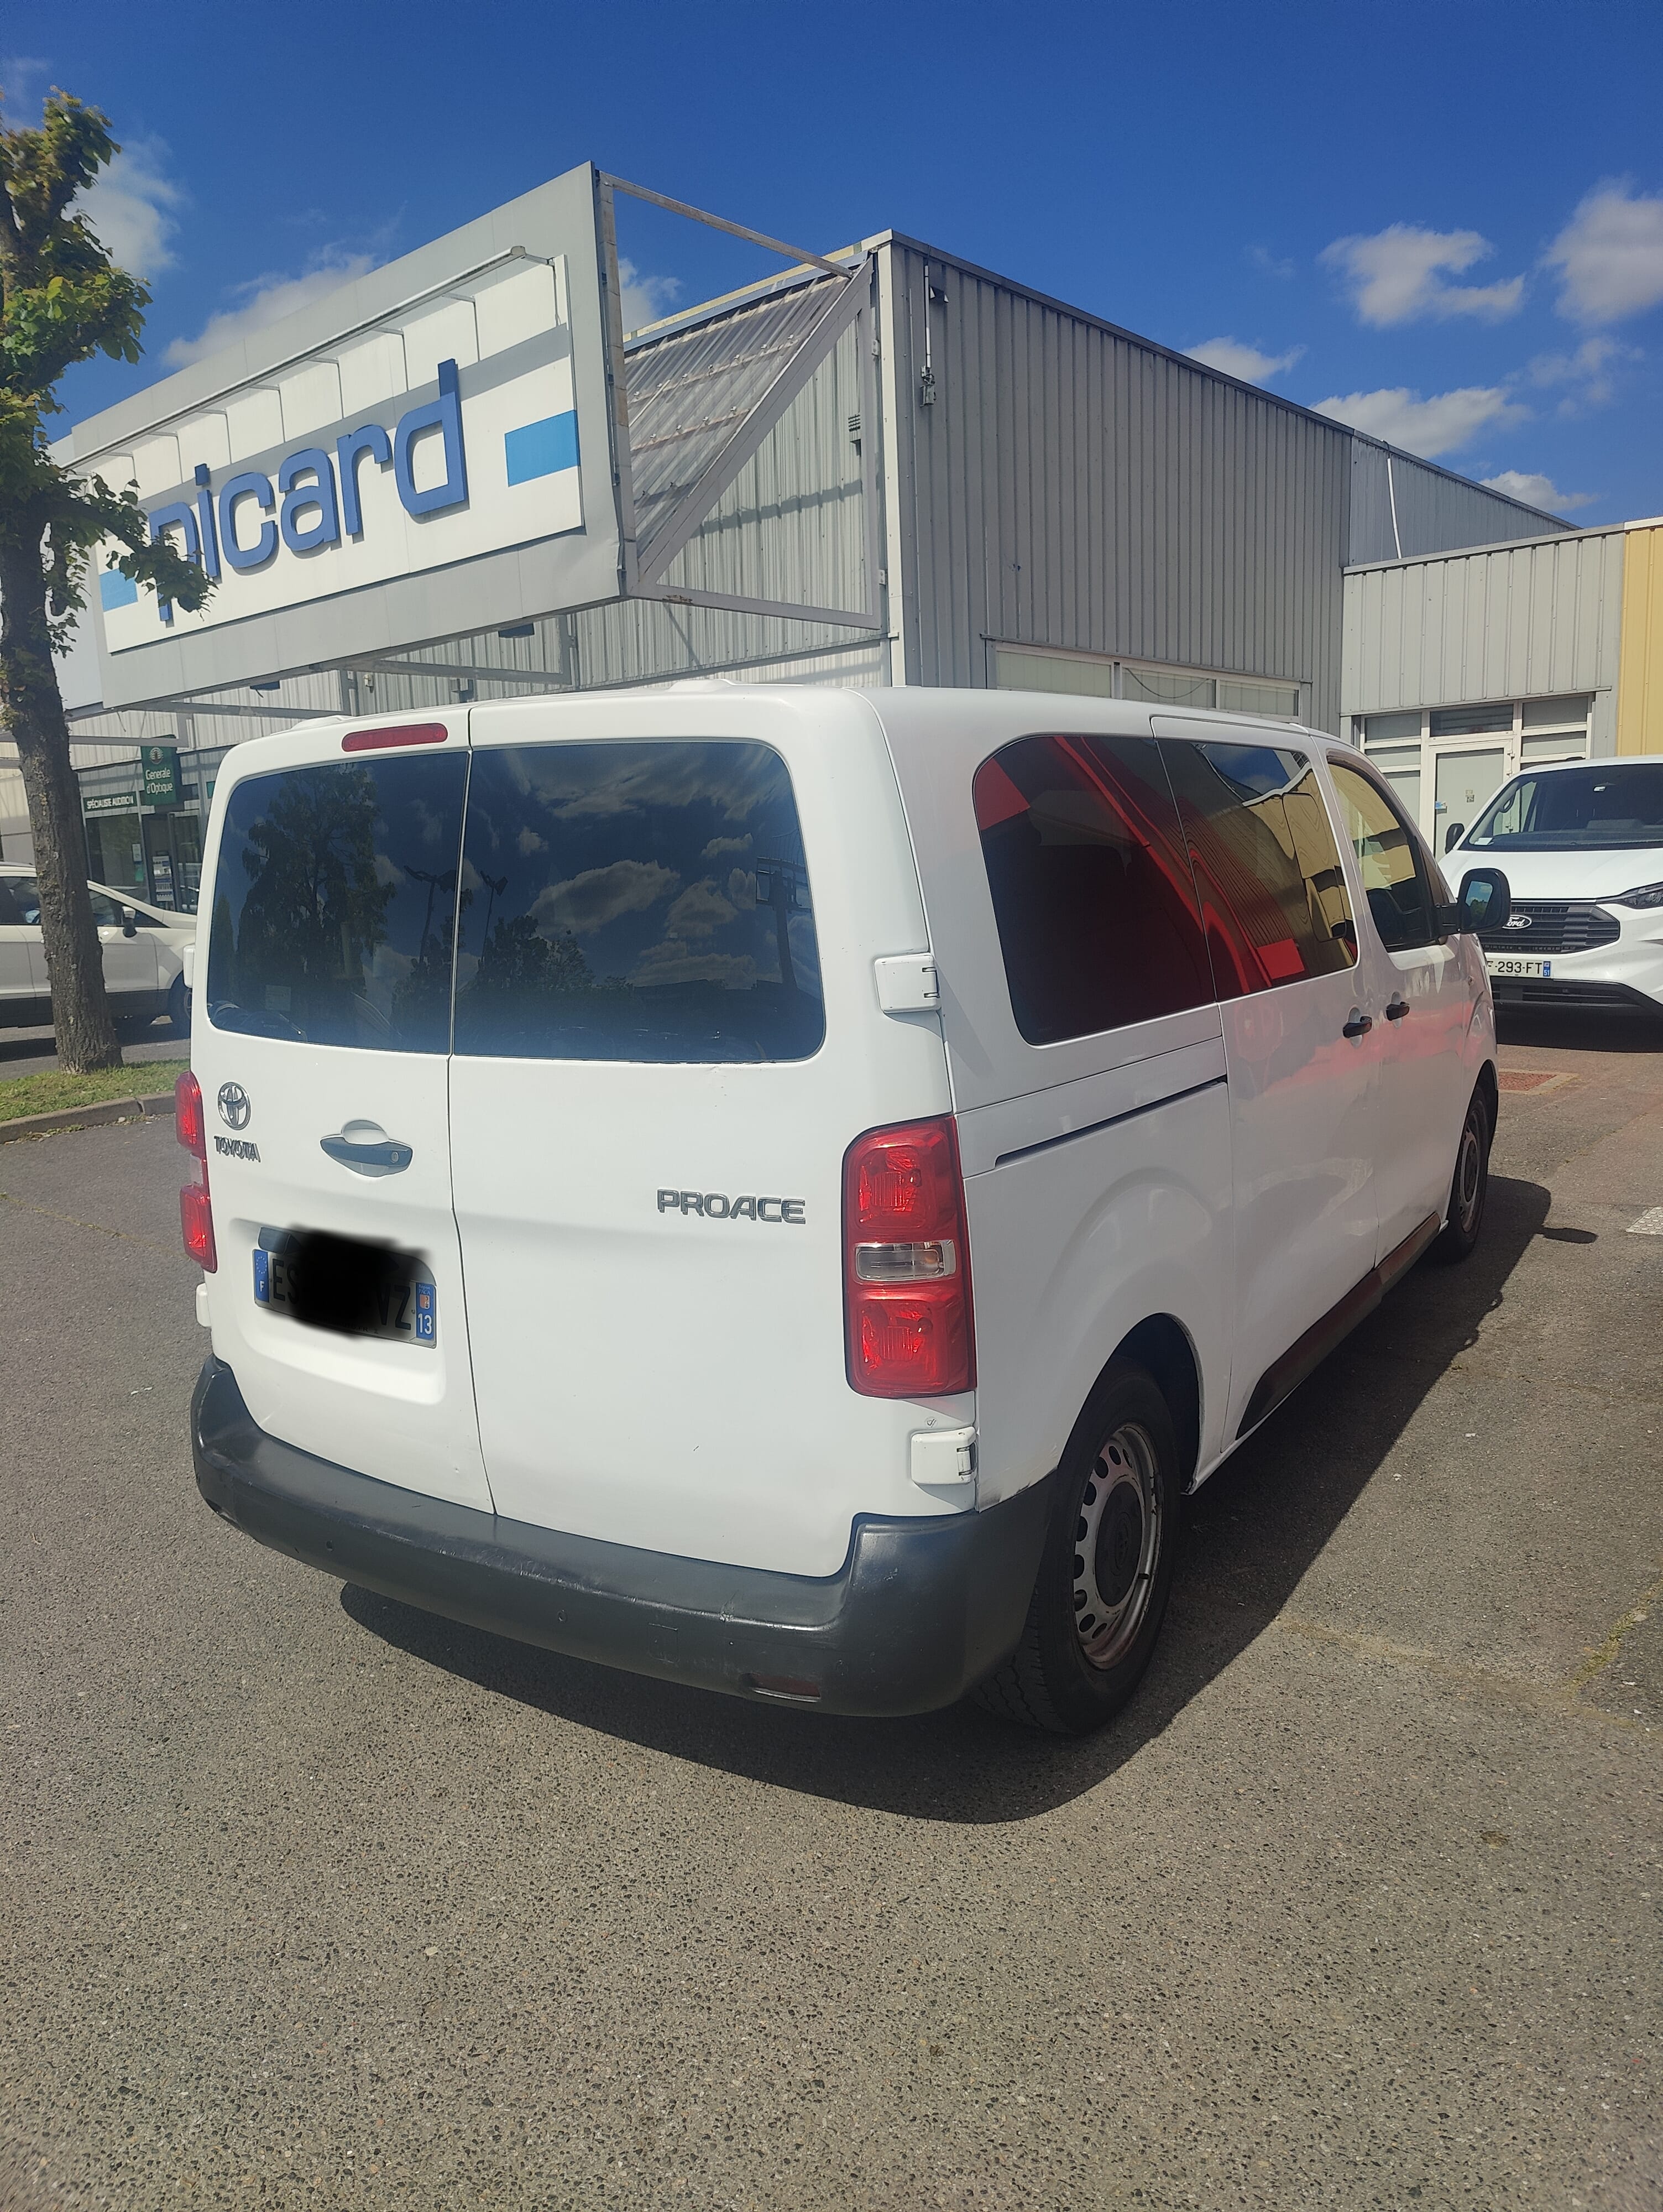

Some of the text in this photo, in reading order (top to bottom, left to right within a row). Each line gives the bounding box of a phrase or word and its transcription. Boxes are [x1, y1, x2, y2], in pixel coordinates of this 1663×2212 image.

[148, 358, 469, 622] picard
[112, 795, 134, 806] AUDITION
[1487, 961, 1542, 974] F-293-FT
[214, 1135, 261, 1162] TOYOTA
[657, 1189, 806, 1224] PROACE
[259, 1280, 265, 1292] F
[418, 1313, 432, 1334] 13
